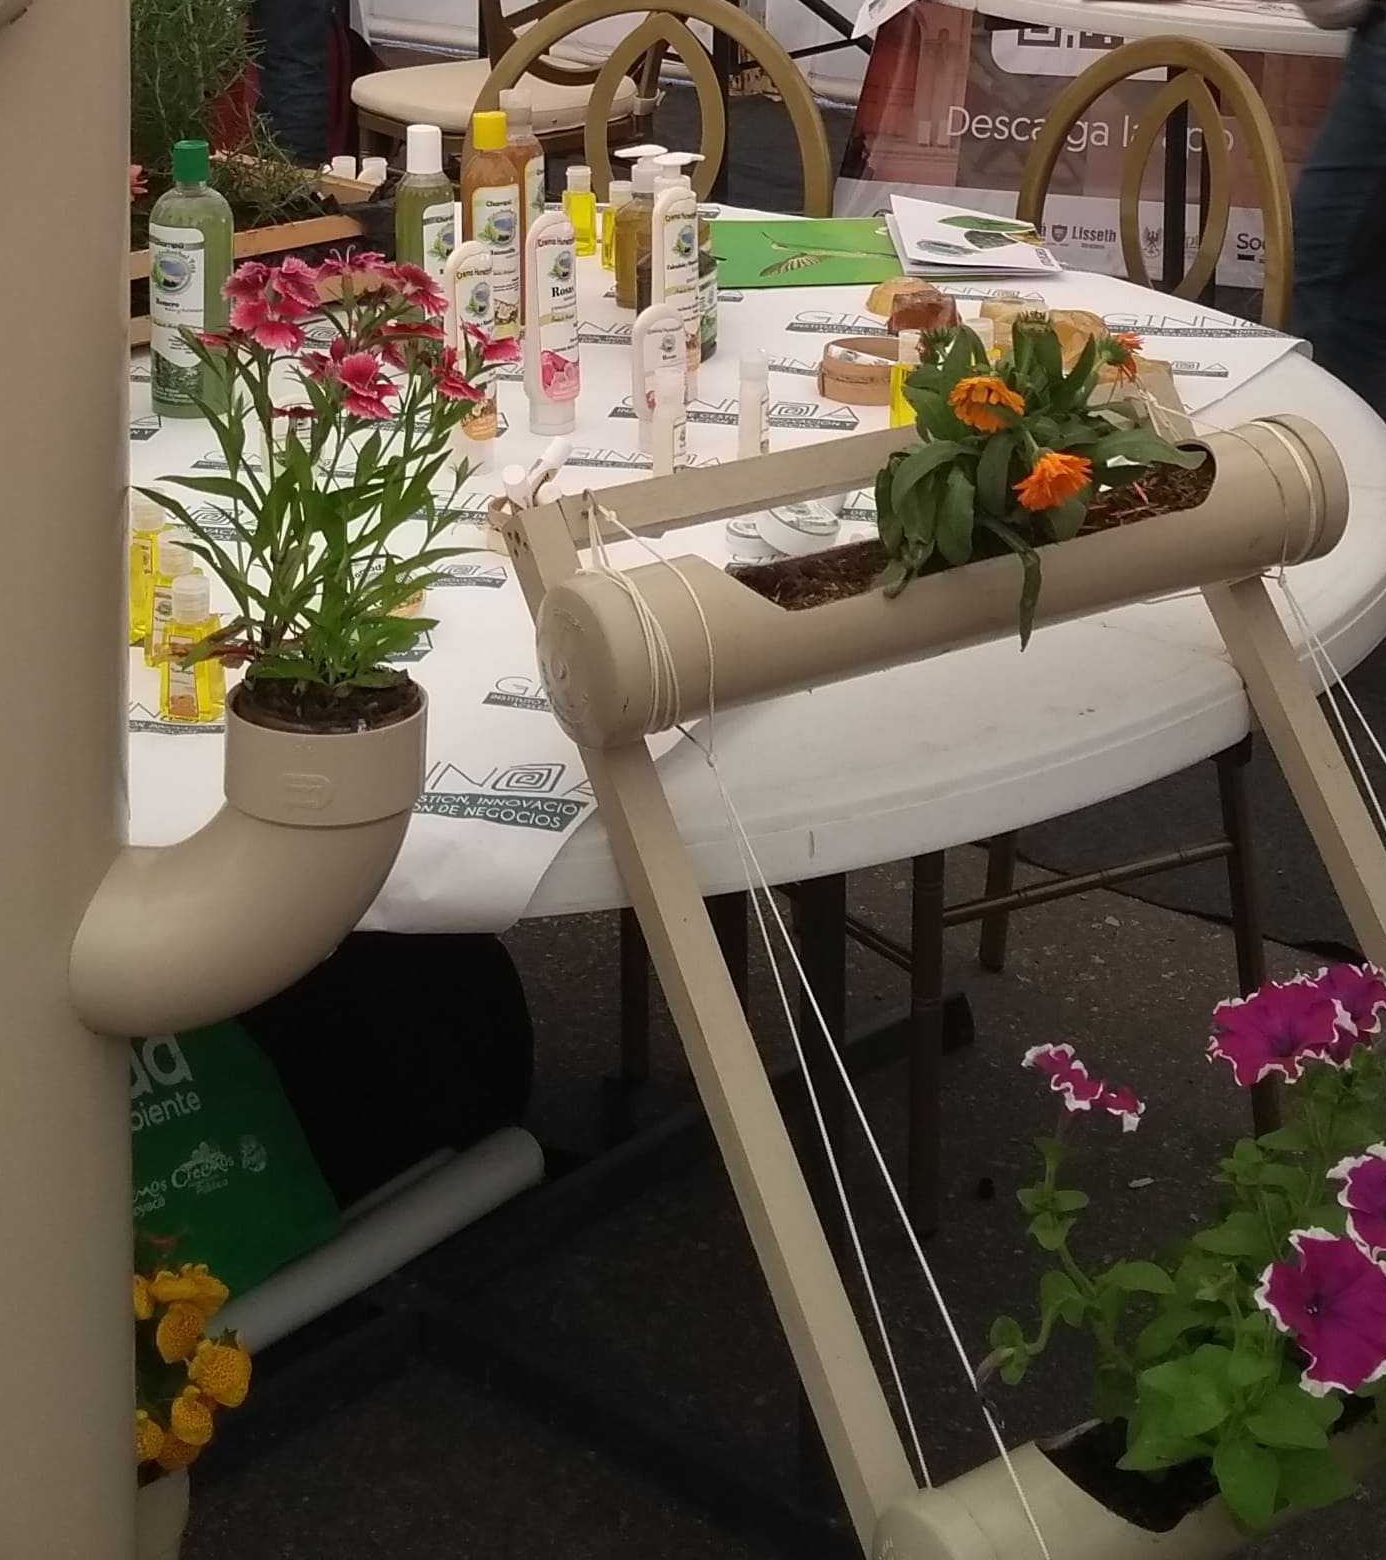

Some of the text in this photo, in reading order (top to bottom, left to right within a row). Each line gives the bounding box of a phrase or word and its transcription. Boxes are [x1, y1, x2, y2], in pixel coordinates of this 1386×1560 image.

[1071, 226, 1116, 242] Lisseth
[438, 804, 560, 827] DE NEGOCIOS
